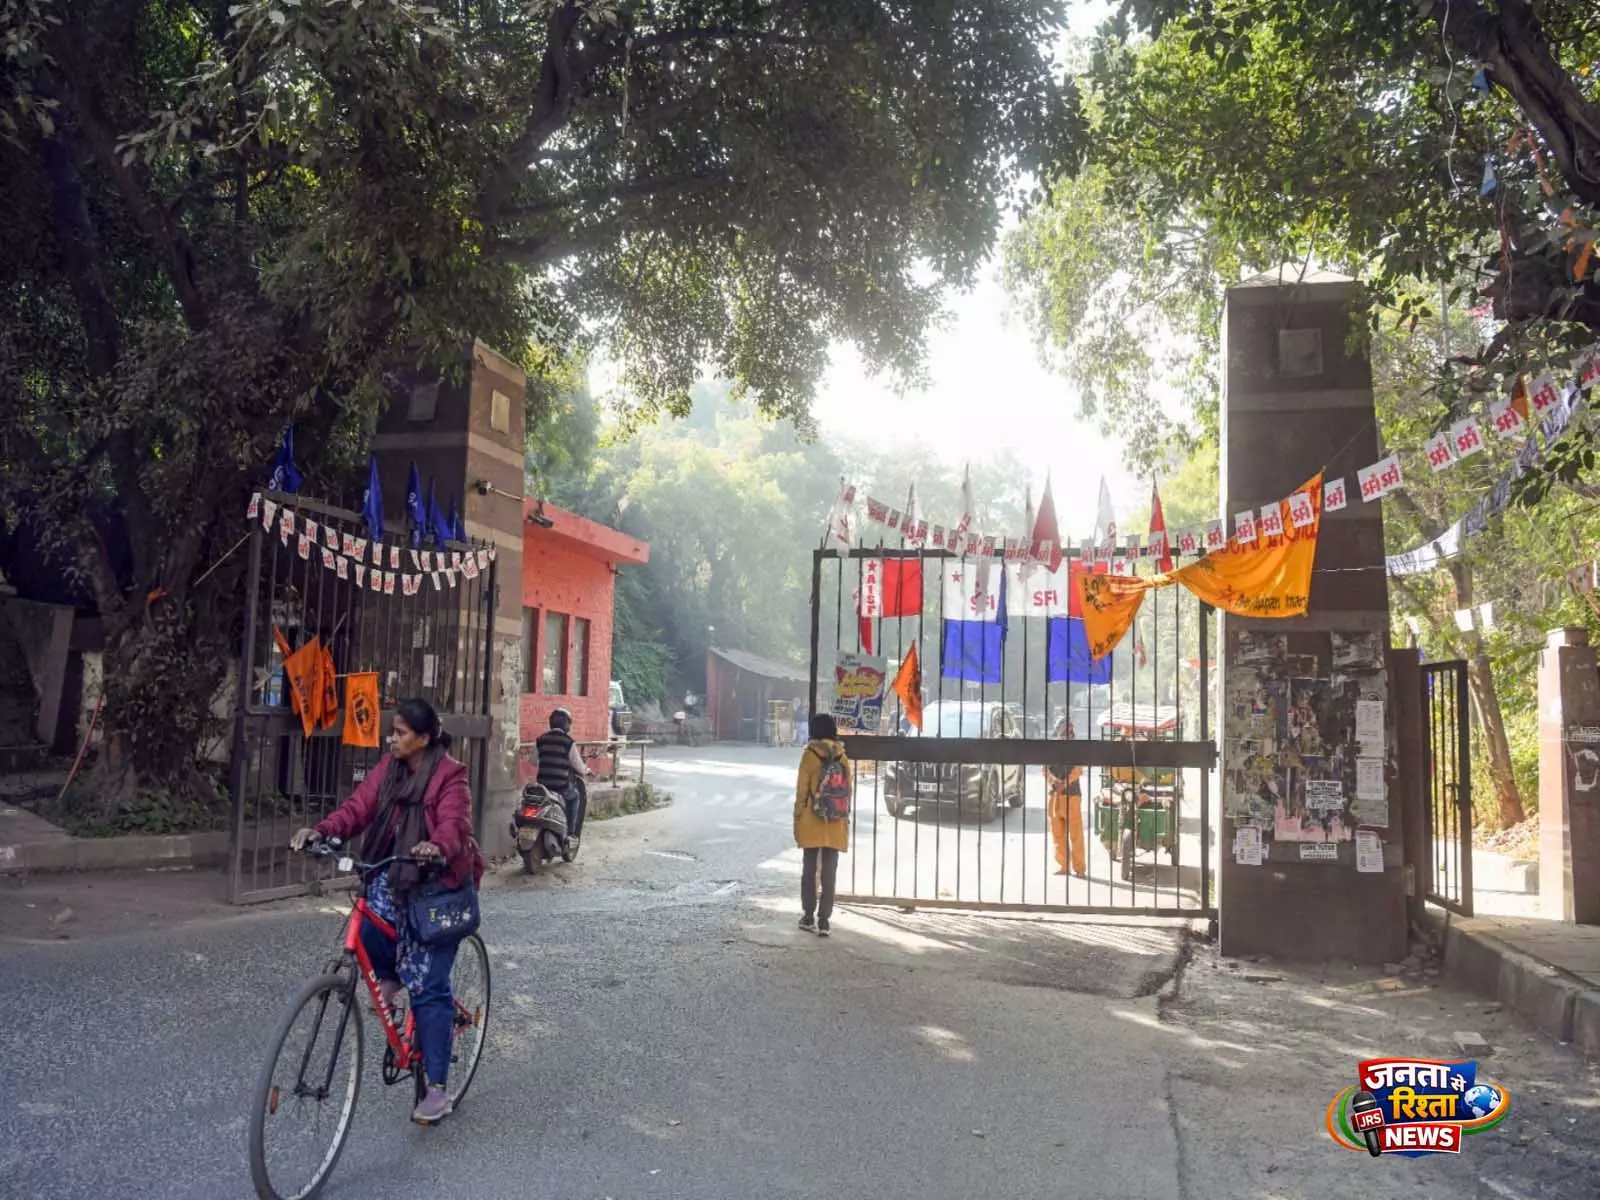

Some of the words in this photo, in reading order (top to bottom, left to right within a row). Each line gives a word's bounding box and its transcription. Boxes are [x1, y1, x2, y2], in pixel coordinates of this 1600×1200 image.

[1533, 384, 1557, 410] SFI
[1495, 412, 1518, 433] SFI
[1457, 432, 1480, 452] SFI
[1429, 446, 1450, 467] SFI
[1326, 486, 1344, 506] SFI
[1263, 514, 1280, 531] SFI
[1293, 505, 1310, 523] SFI
[1033, 590, 1057, 606] SFI
